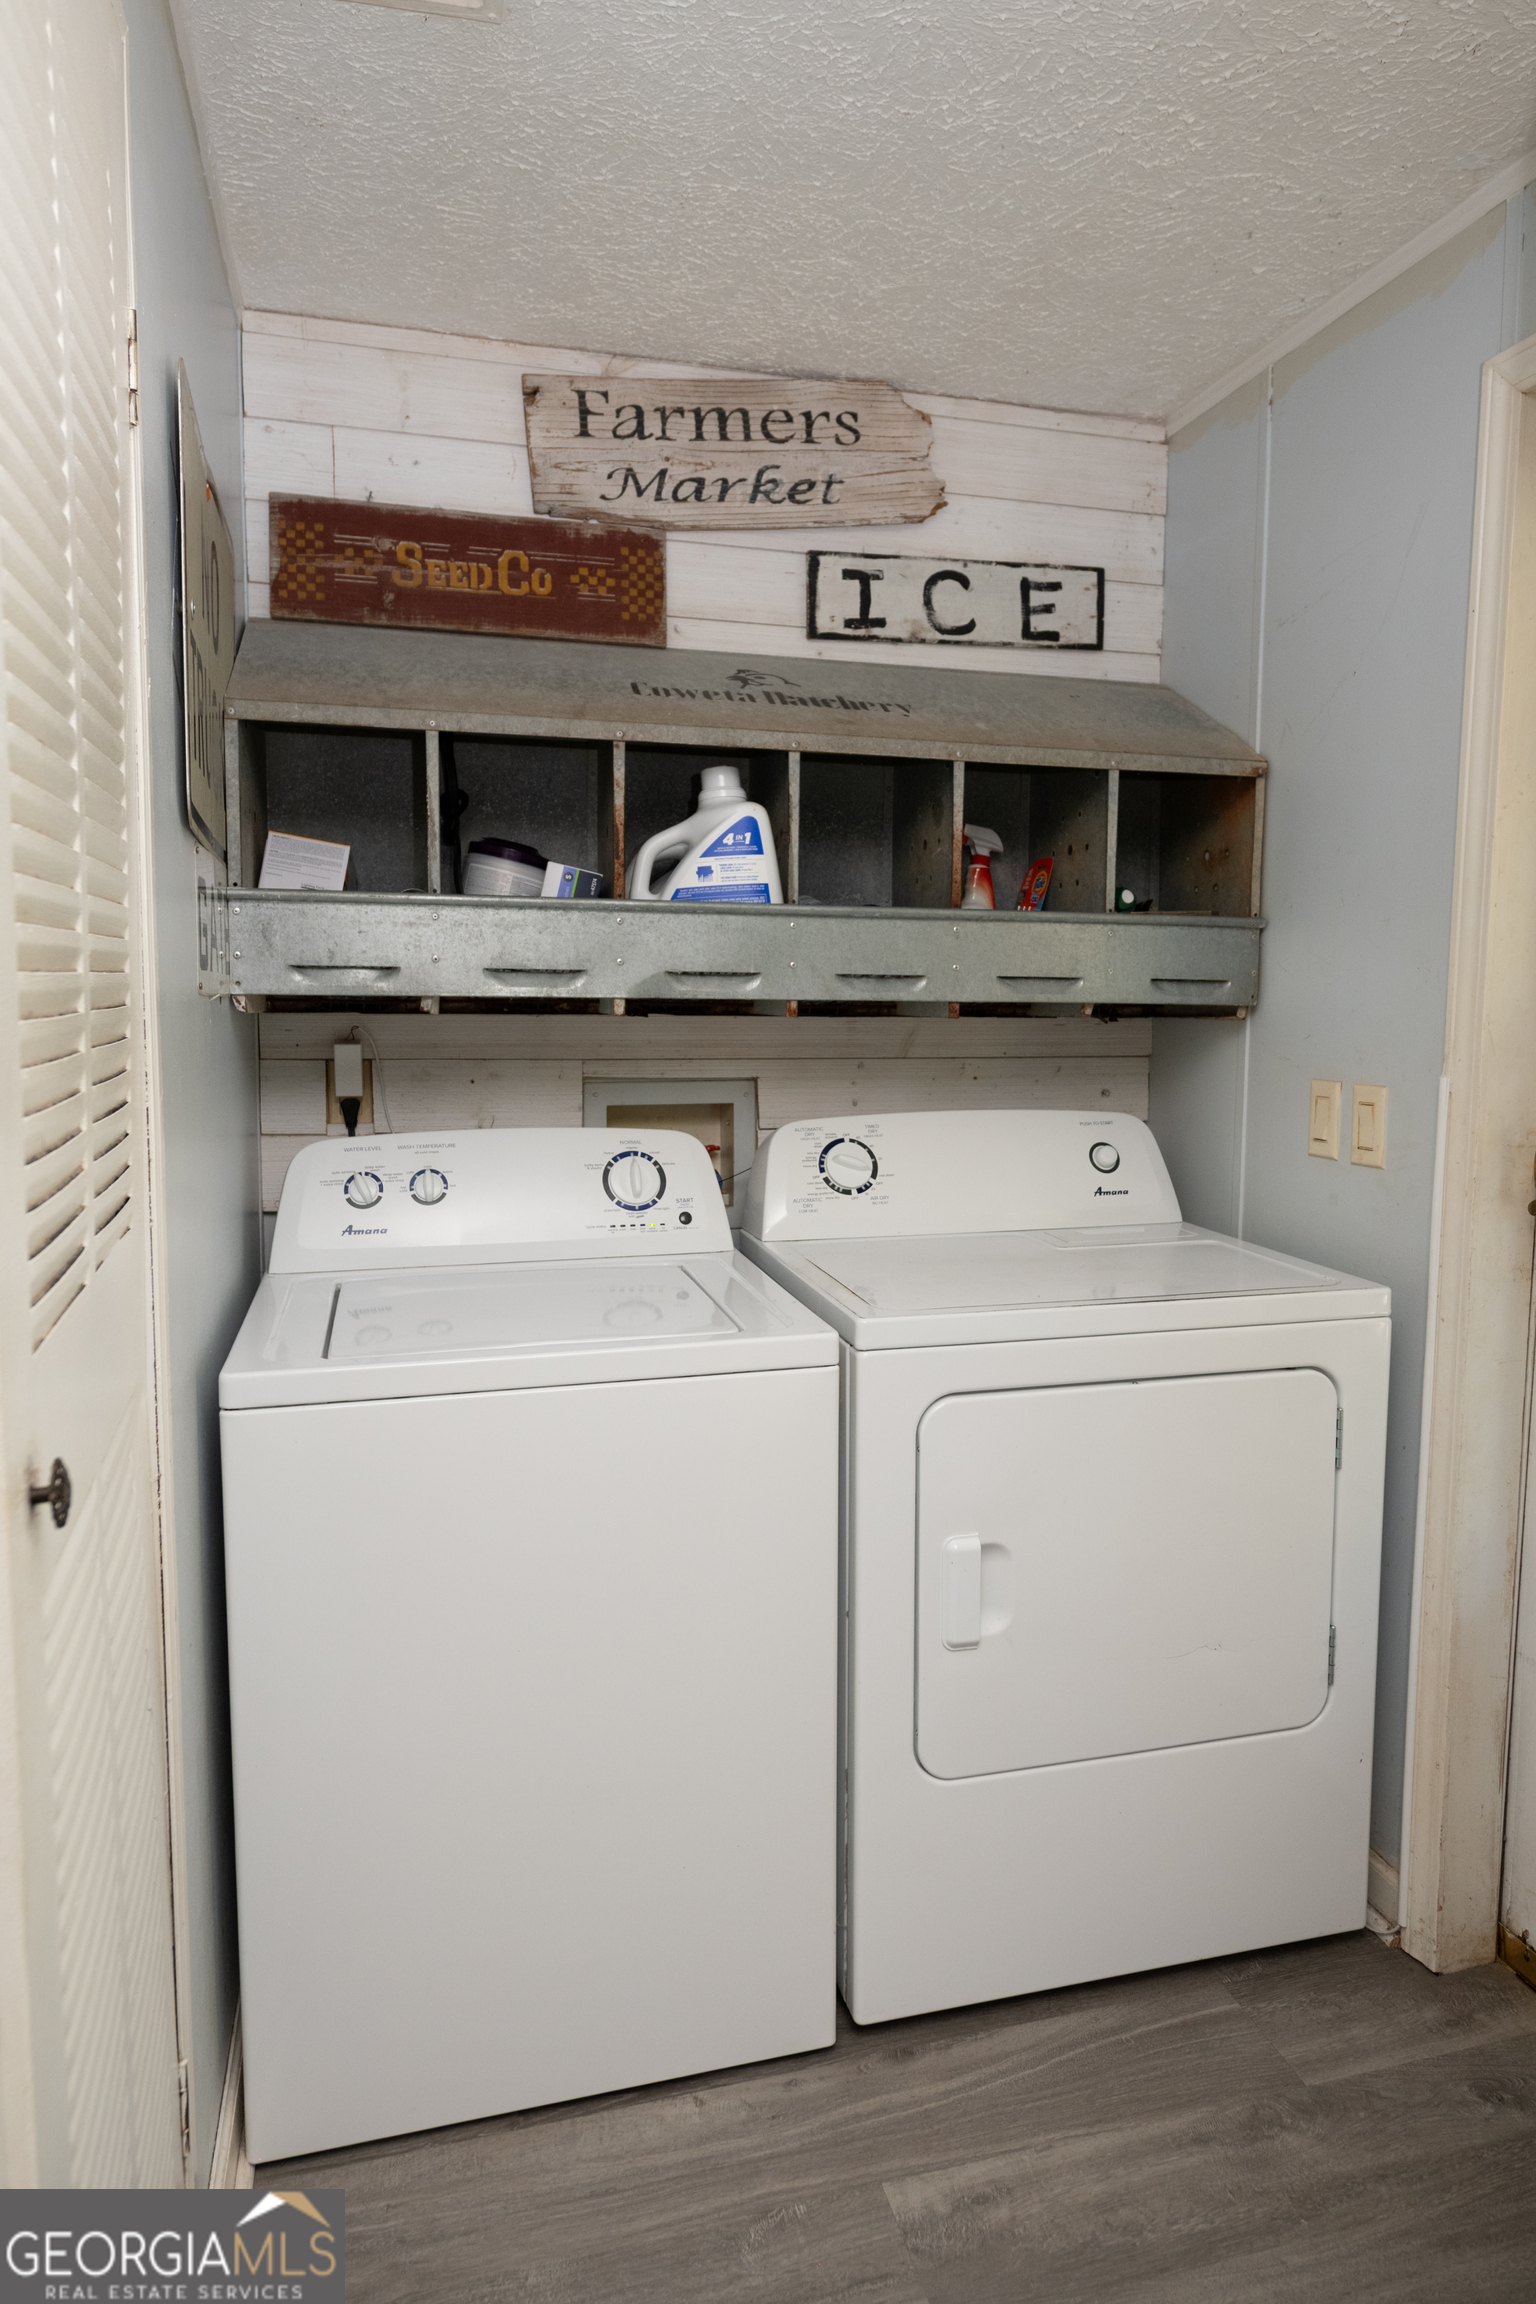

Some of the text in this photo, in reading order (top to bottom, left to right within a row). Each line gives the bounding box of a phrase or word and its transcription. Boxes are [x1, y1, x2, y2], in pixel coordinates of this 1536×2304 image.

[571, 389, 861, 445] Farmers
[600, 464, 845, 506] Market
[841, 568, 1063, 642] ICE
[630, 682, 912, 717] Coweta Hatchery
[722, 832, 734, 845] 4
[744, 832, 751, 845] 1
[1094, 1186, 1129, 1197] Amana
[341, 1224, 388, 1236] Amana
